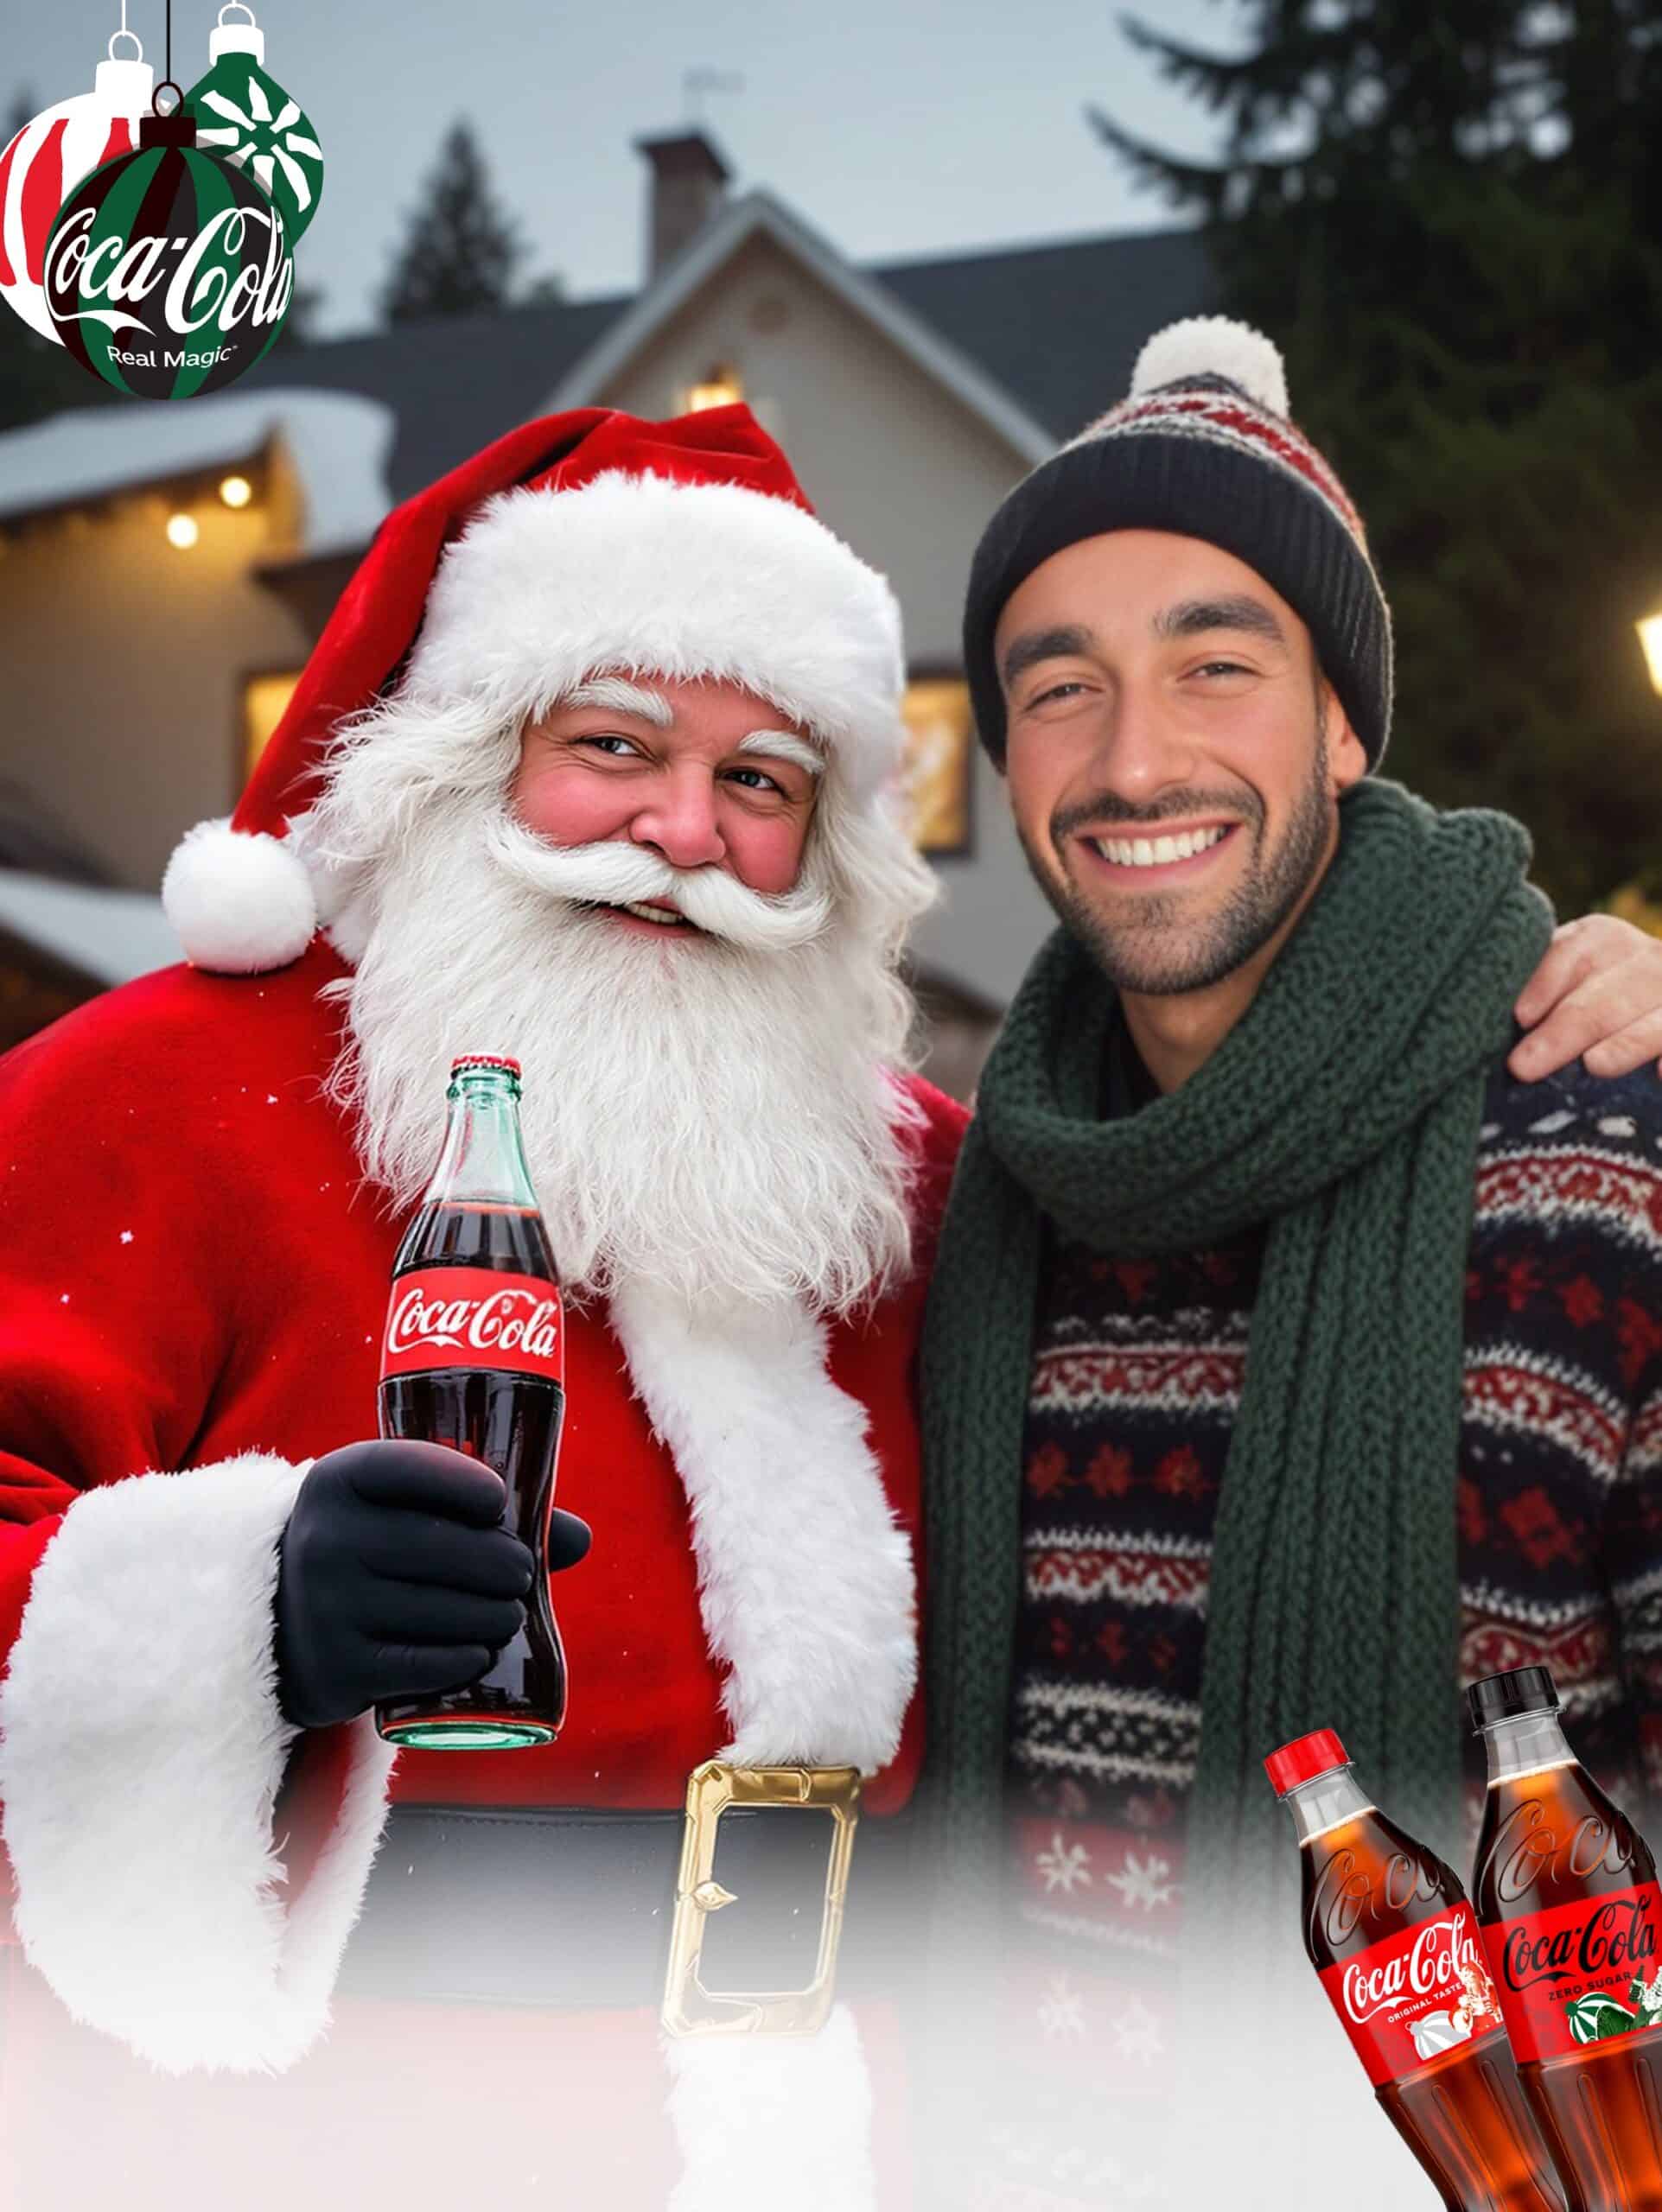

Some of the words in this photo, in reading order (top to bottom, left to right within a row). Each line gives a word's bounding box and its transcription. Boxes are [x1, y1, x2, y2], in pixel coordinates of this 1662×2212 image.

[387, 1288, 557, 1358] Coca-Cola
[1342, 1910, 1478, 2024] Coca-Cola
[1502, 1894, 1657, 1993] Coca-Cola
[1387, 1998, 1433, 2024] ORIGINAL
[1433, 1982, 1463, 2001] TASTE
[1548, 1984, 1583, 2002] ZERO
[1586, 1971, 1632, 1991] SUGAR
